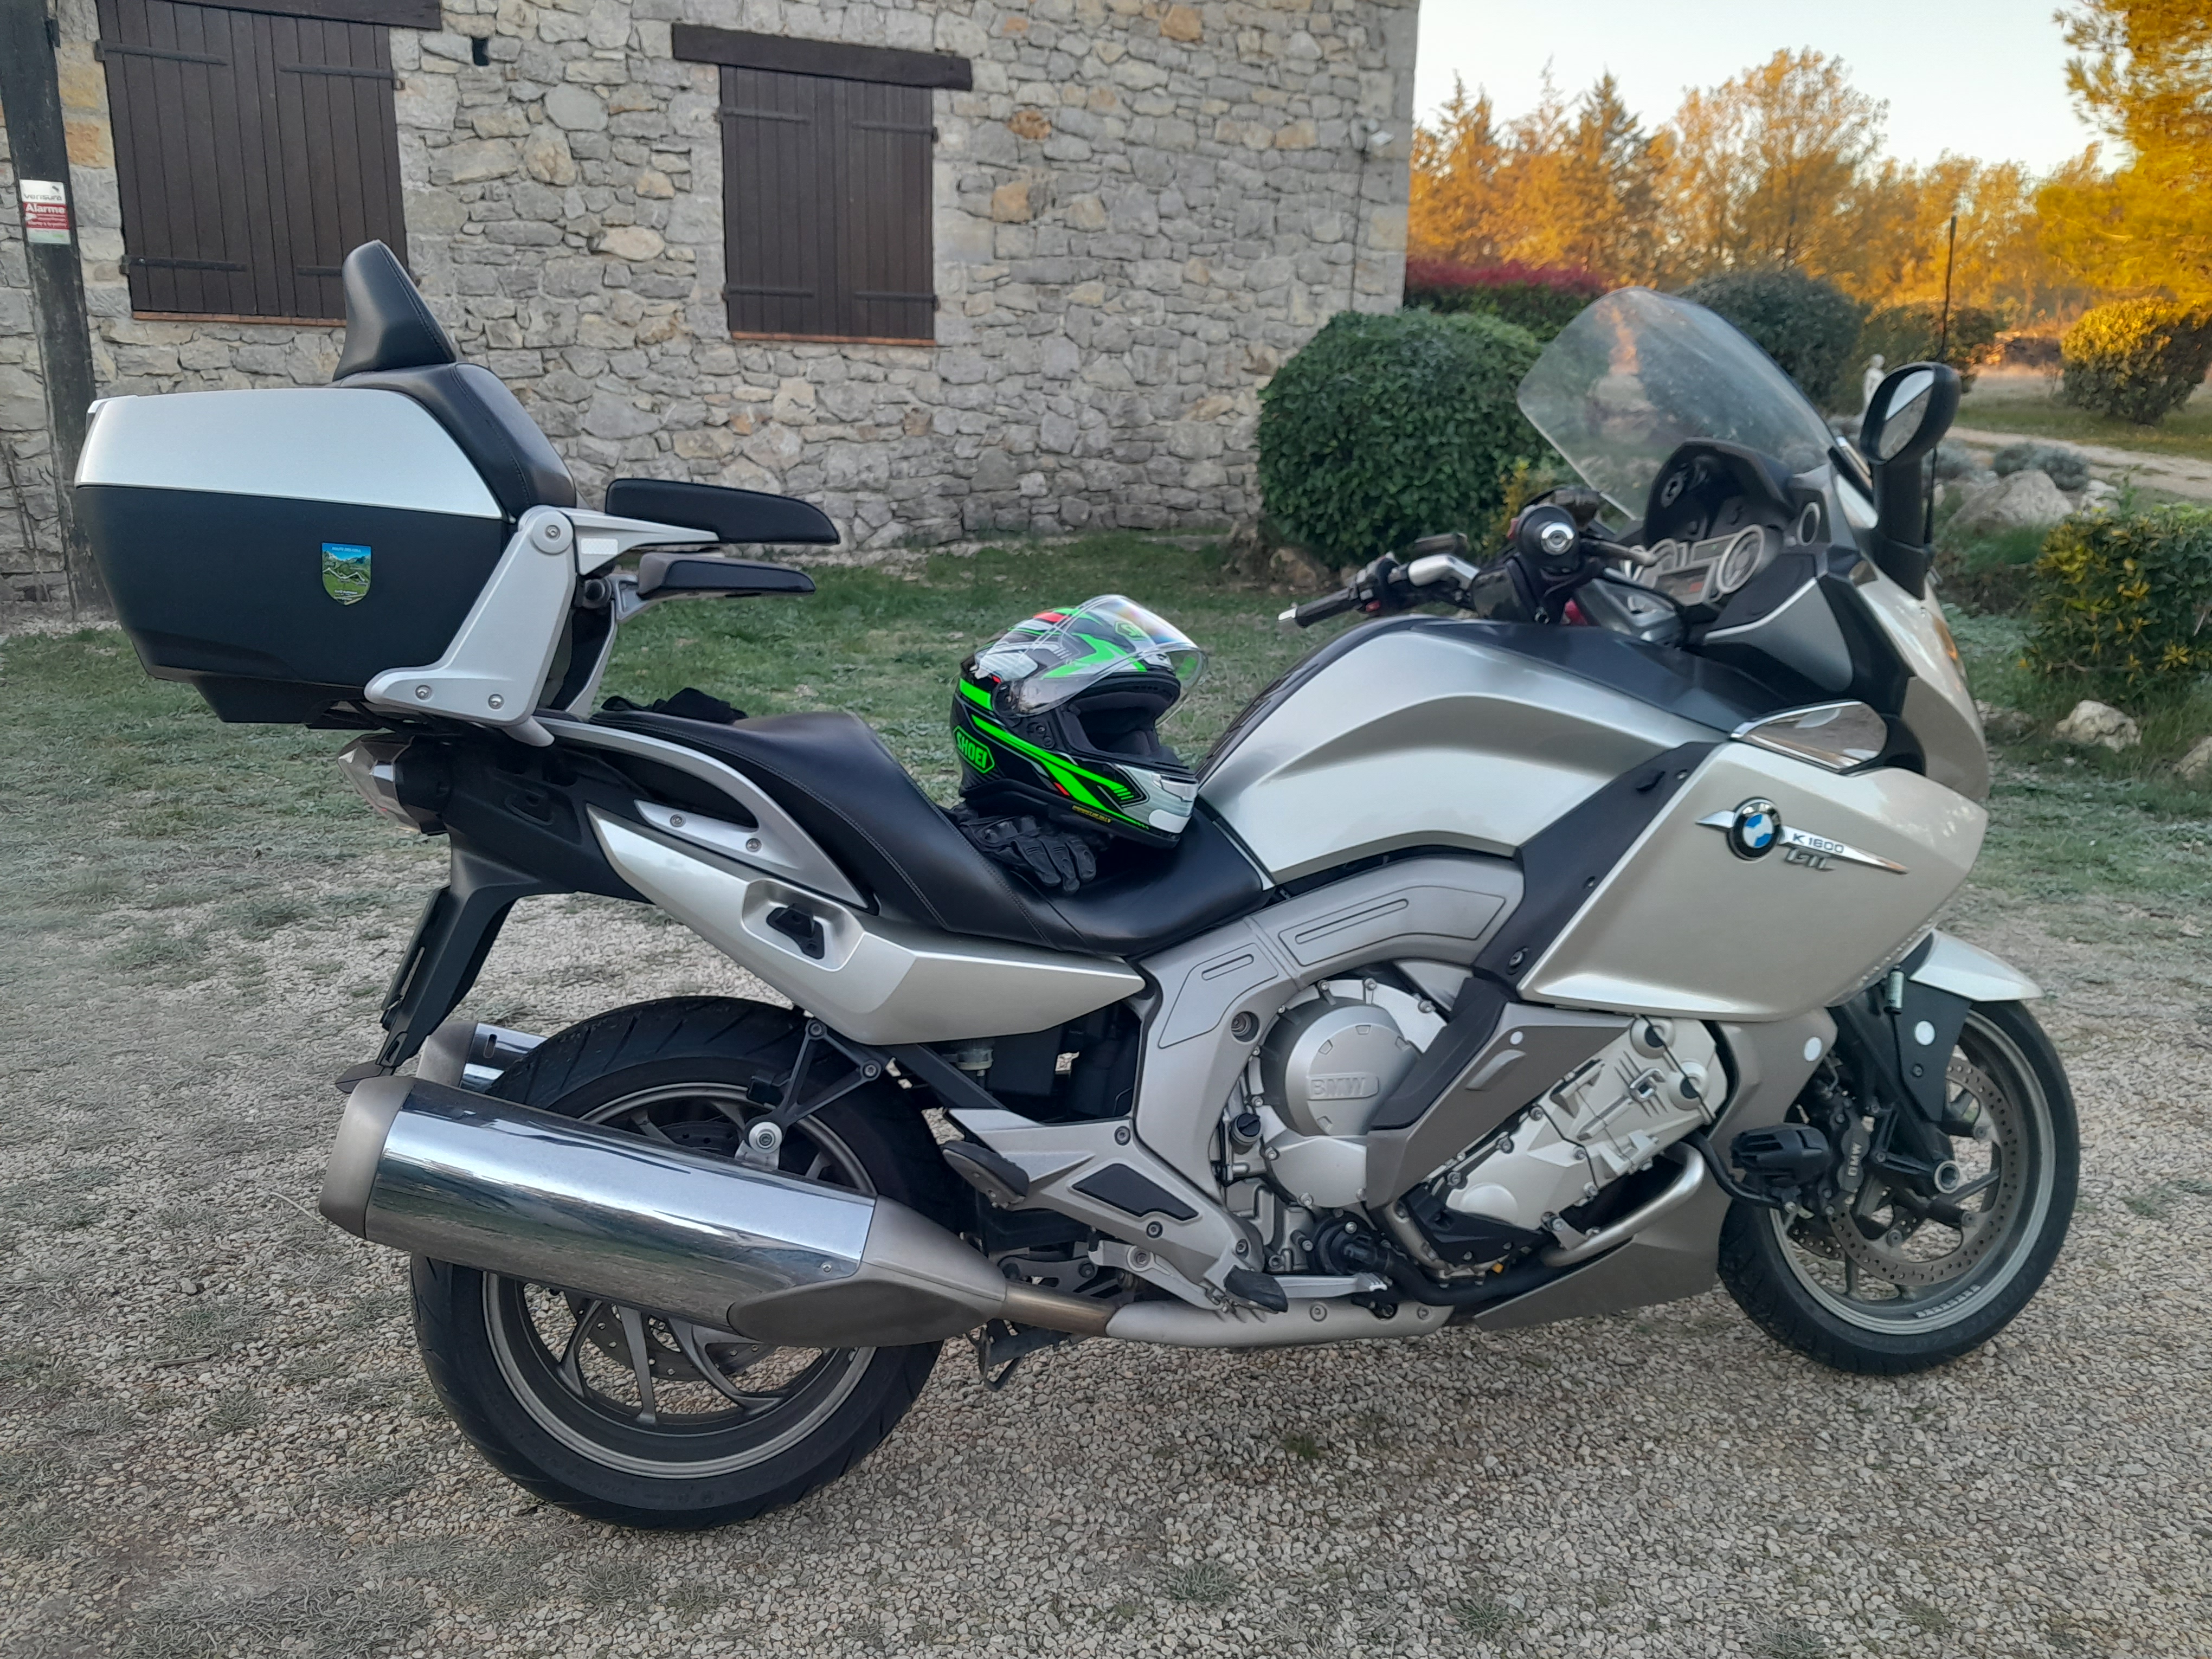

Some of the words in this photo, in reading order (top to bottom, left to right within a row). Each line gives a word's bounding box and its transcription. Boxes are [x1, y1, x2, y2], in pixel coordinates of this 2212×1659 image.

[25, 203, 65, 214] Alarme
[956, 732, 987, 768] SHOEI
[1793, 833, 1805, 844] K
[1809, 838, 1844, 853] 1600
[1311, 1077, 1366, 1096] BMW
